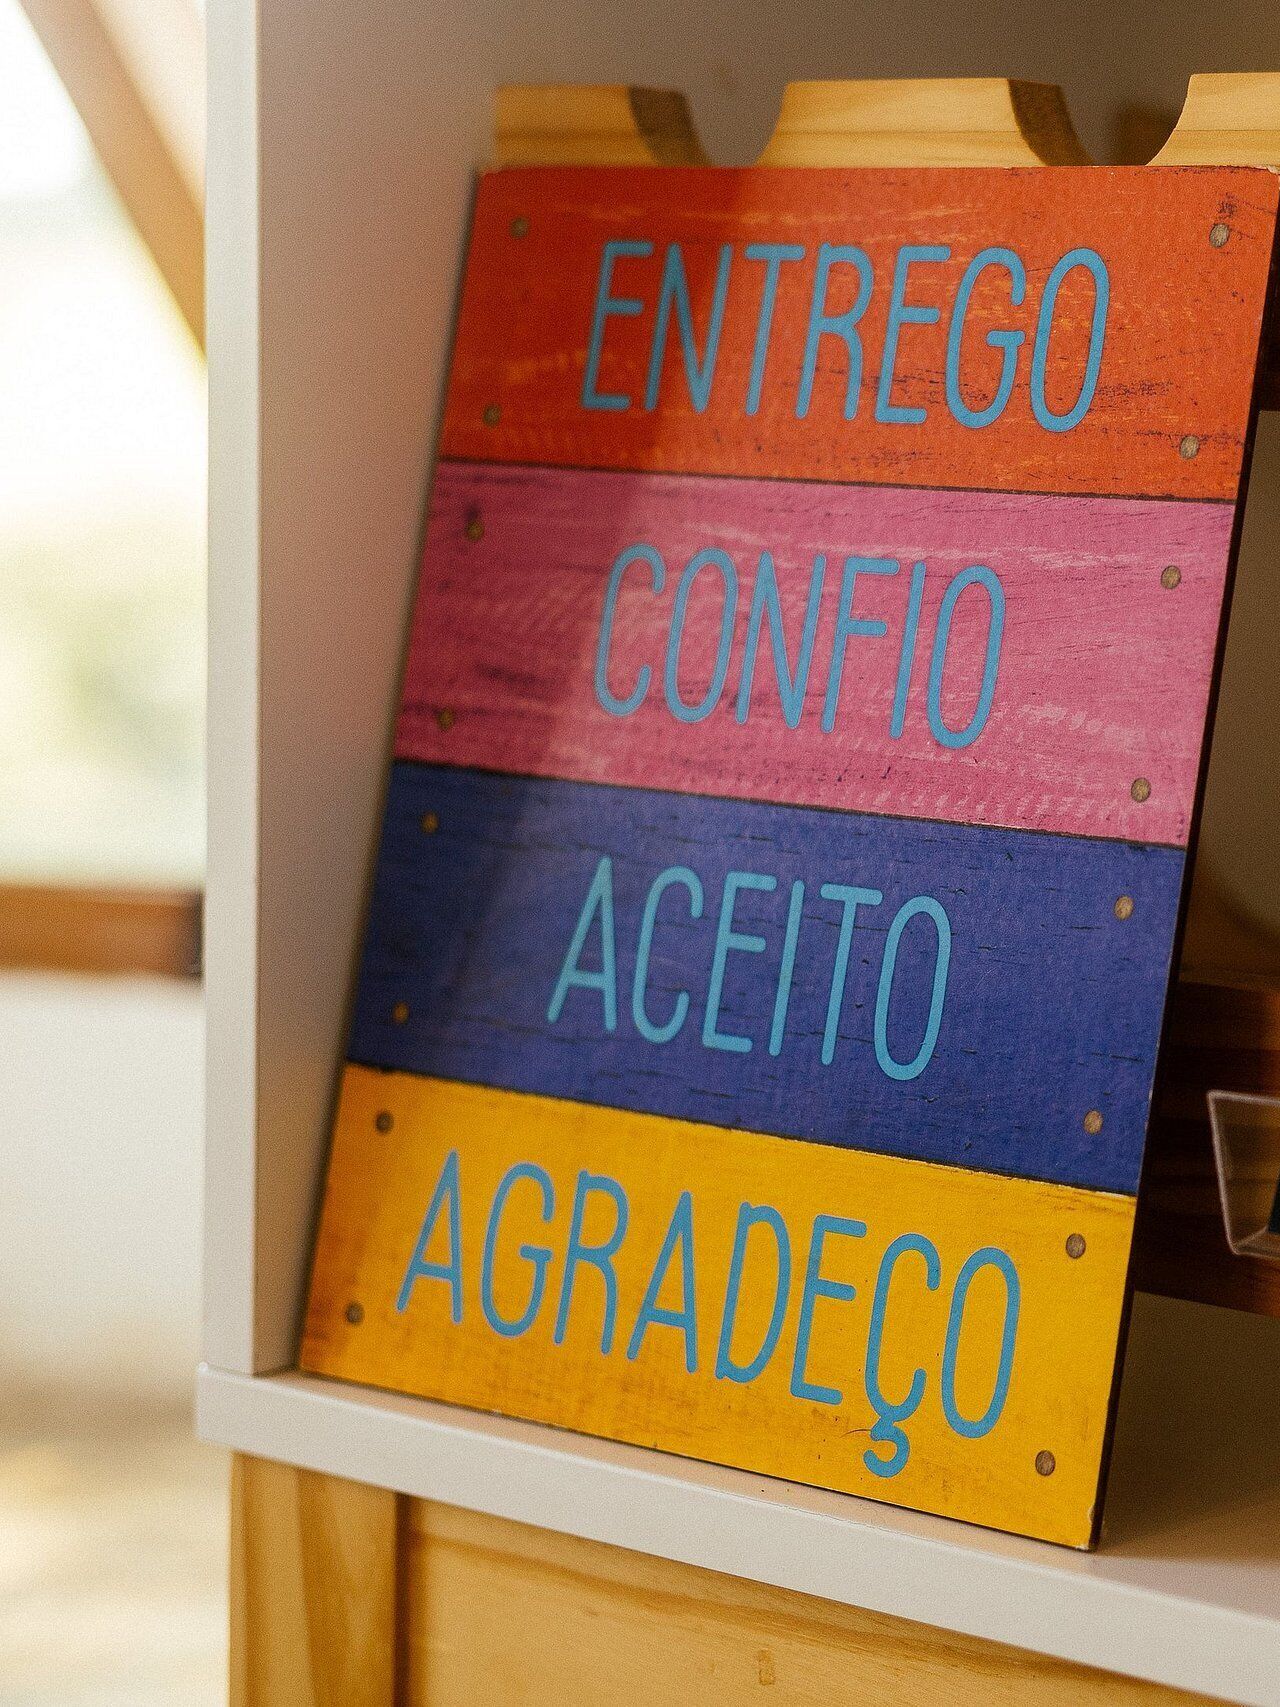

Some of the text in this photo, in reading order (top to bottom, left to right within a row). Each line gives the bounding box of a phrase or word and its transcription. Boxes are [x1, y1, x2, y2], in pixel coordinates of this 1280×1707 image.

[580, 241, 1111, 432] ENTREGO
[594, 543, 1005, 750] CONFIO
[546, 857, 952, 1081] ACEITO
[397, 1149, 1021, 1478] AGRADEÇO
